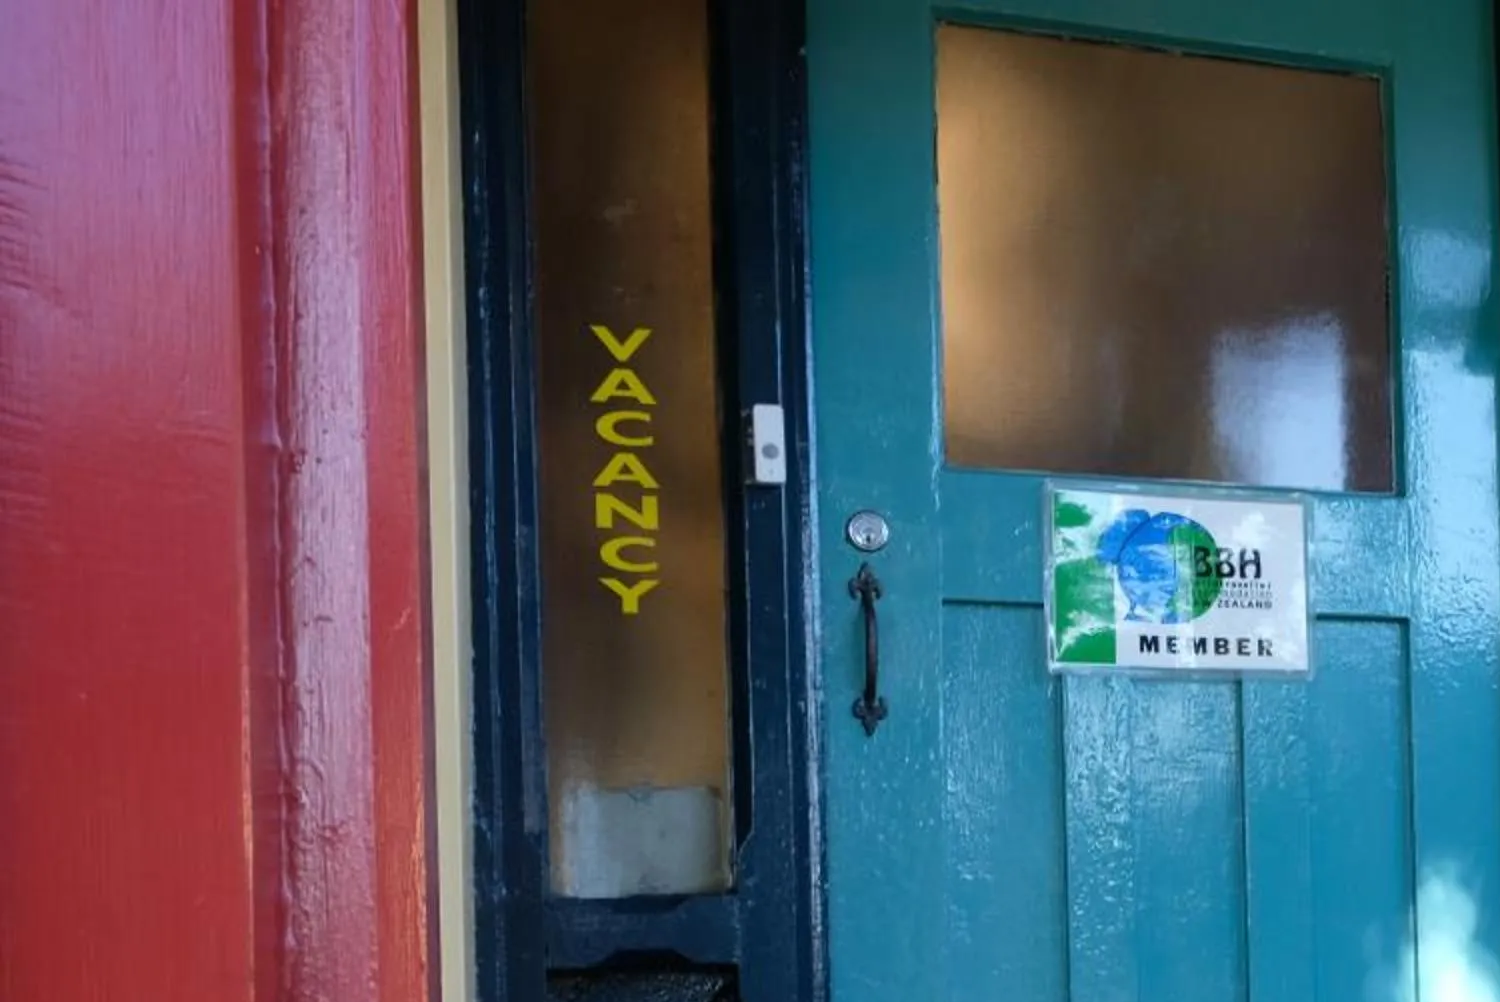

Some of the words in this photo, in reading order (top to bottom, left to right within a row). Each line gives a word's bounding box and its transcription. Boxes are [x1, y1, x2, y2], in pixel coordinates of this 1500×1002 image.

[590, 324, 660, 614] VACANCY
[1194, 545, 1262, 579] BBH
[1139, 634, 1273, 657] MEMBER
